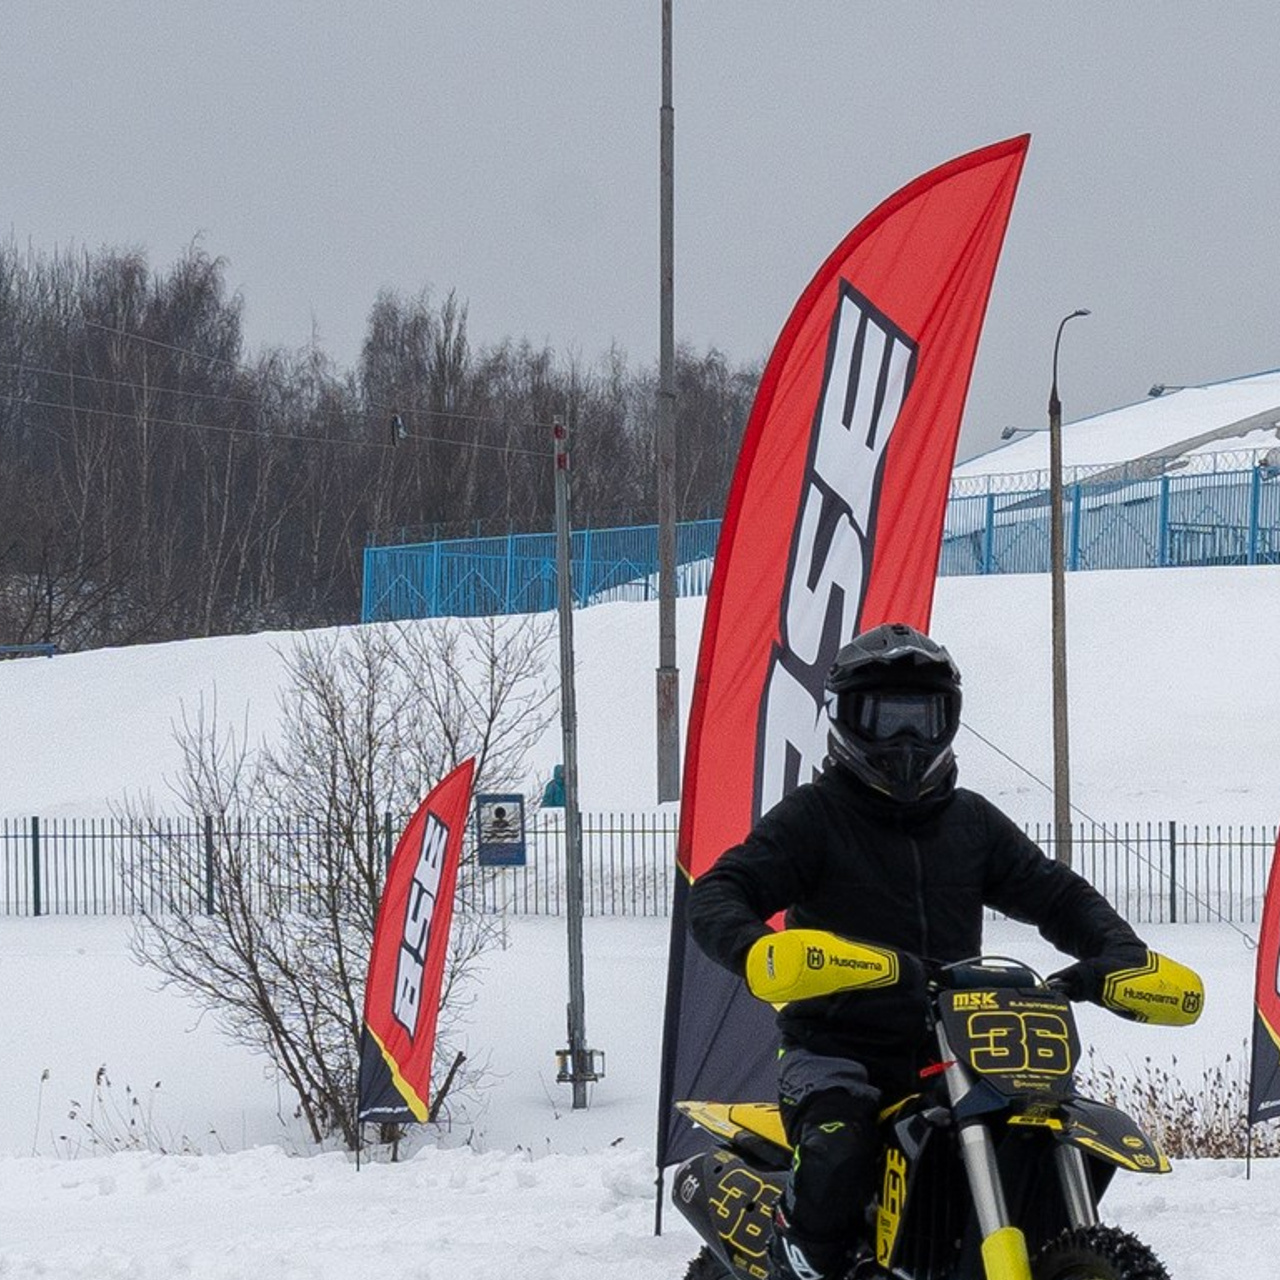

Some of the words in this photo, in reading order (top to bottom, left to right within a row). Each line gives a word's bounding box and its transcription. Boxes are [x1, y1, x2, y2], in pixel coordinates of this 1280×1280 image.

[392, 810, 450, 1041] BSE
[829, 955, 882, 971] Husqvarna
[953, 992, 998, 1005] MSK
[1123, 987, 1179, 1005] Husqvarna
[968, 1011, 1071, 1074] 36
